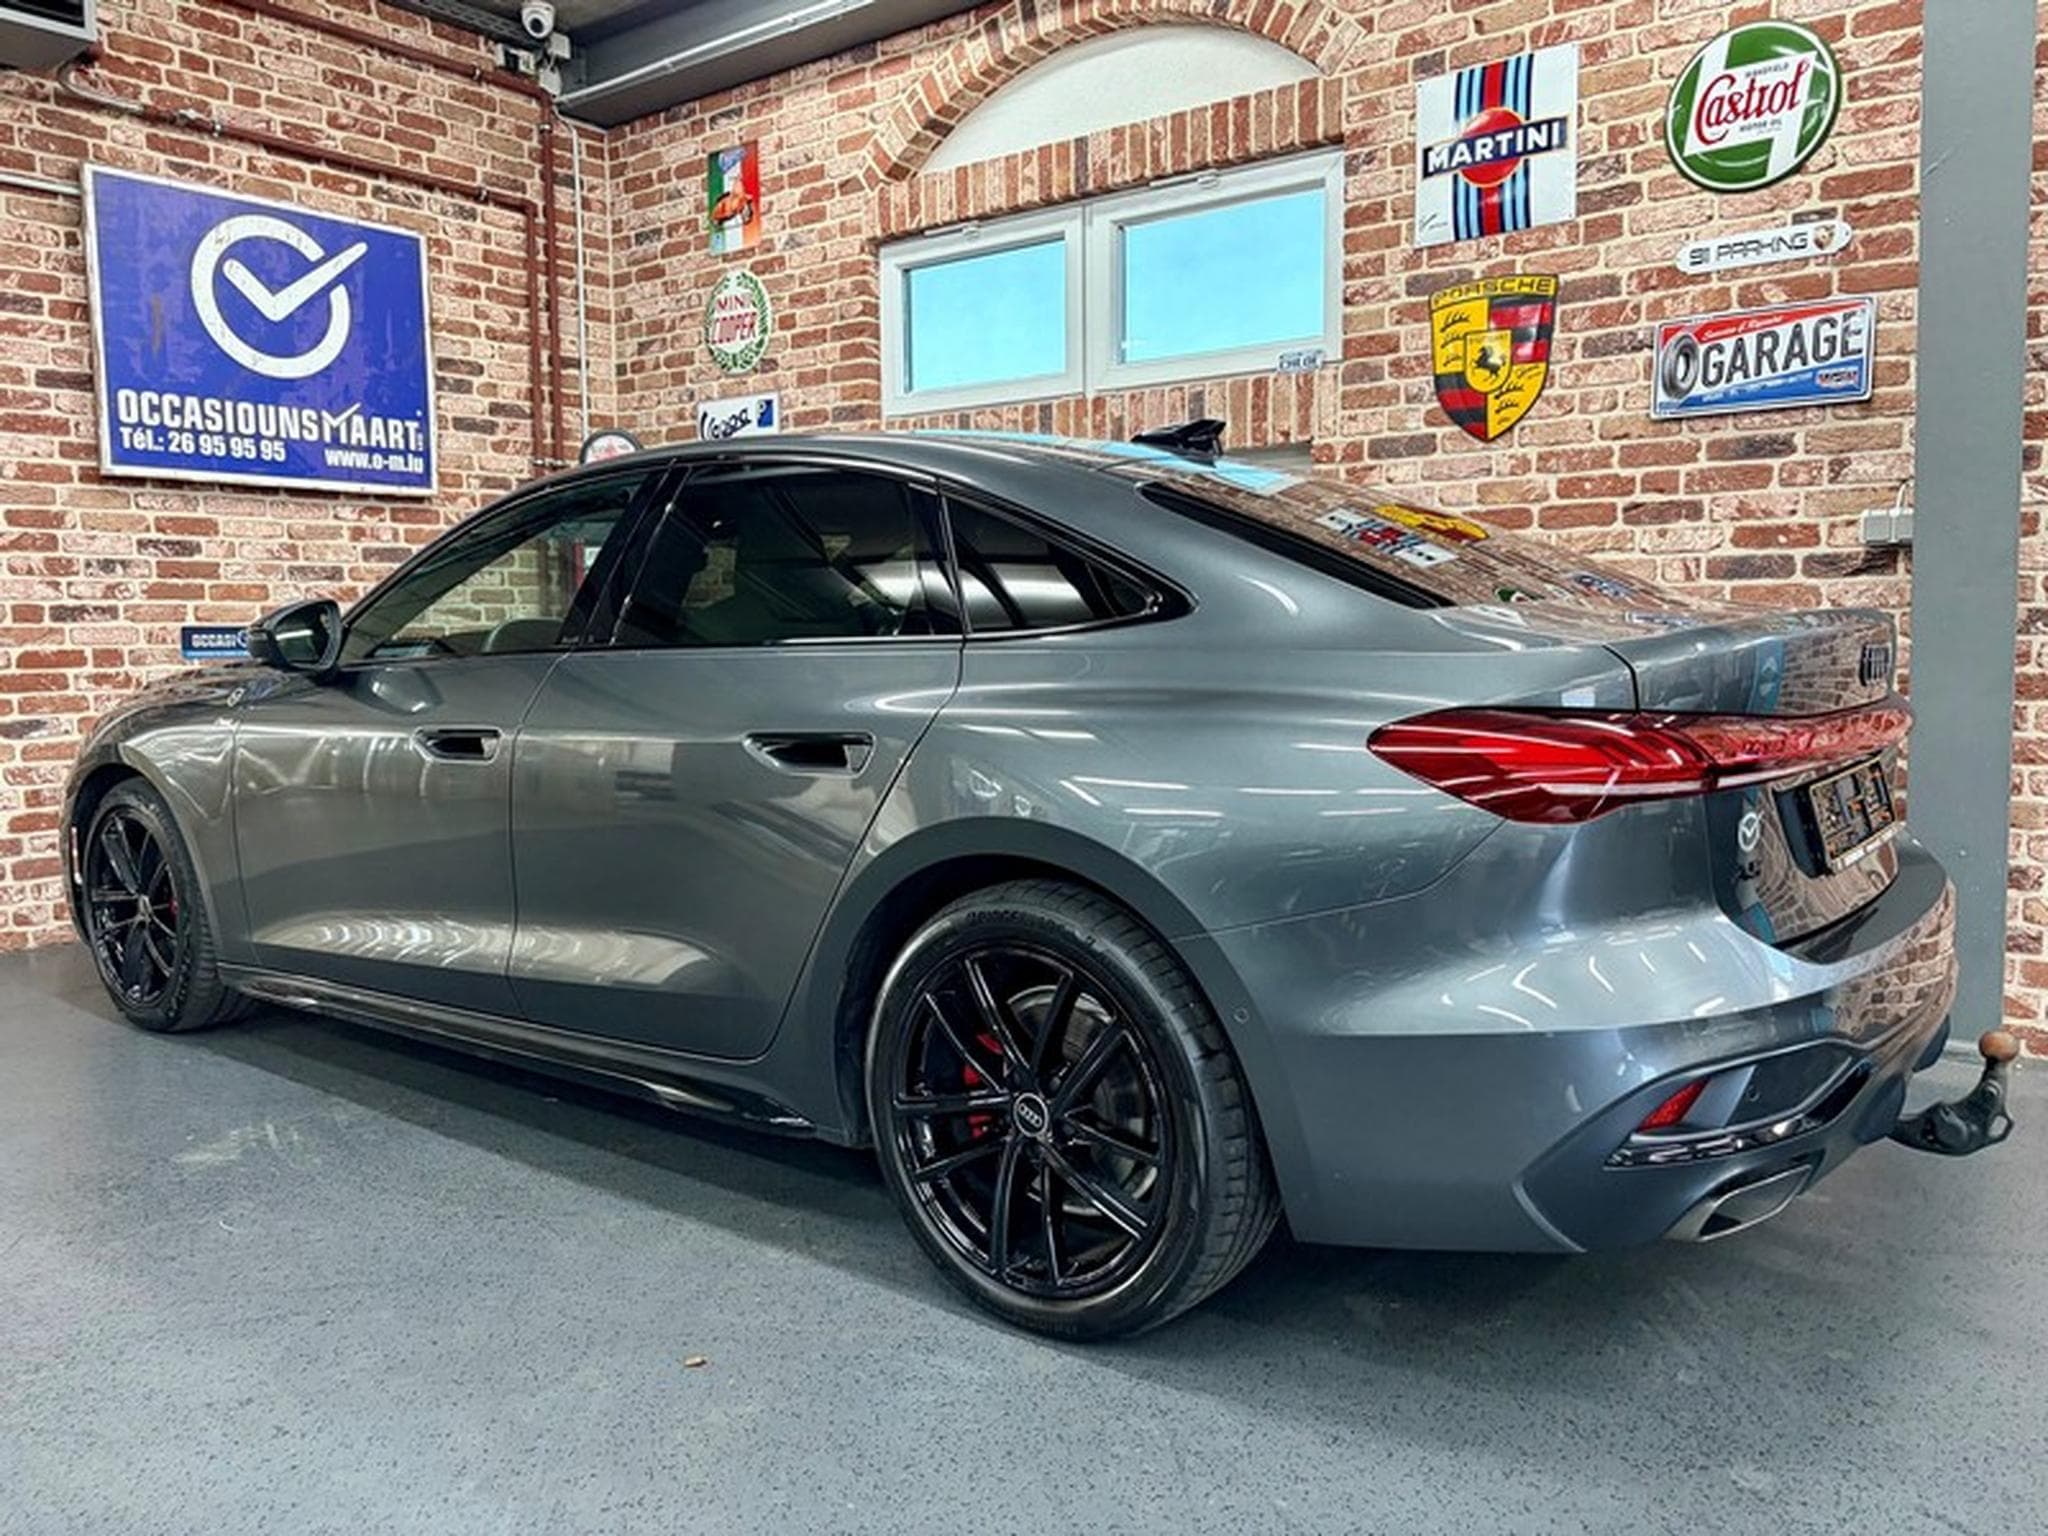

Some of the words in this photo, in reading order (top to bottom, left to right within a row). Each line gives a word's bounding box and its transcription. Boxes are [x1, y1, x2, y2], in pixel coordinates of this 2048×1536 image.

[1694, 56, 1811, 146] Castrol
[1427, 121, 1561, 174] MARTINI
[1715, 232, 1809, 261] PARKING
[1434, 278, 1552, 305] PORSCHE
[1701, 308, 1865, 389] GARAGE
[167, 431, 196, 455] 26
[199, 433, 226, 457] 95
[230, 436, 257, 460] 95
[260, 439, 287, 463] 95
[324, 448, 425, 475] www.o-m.lu
